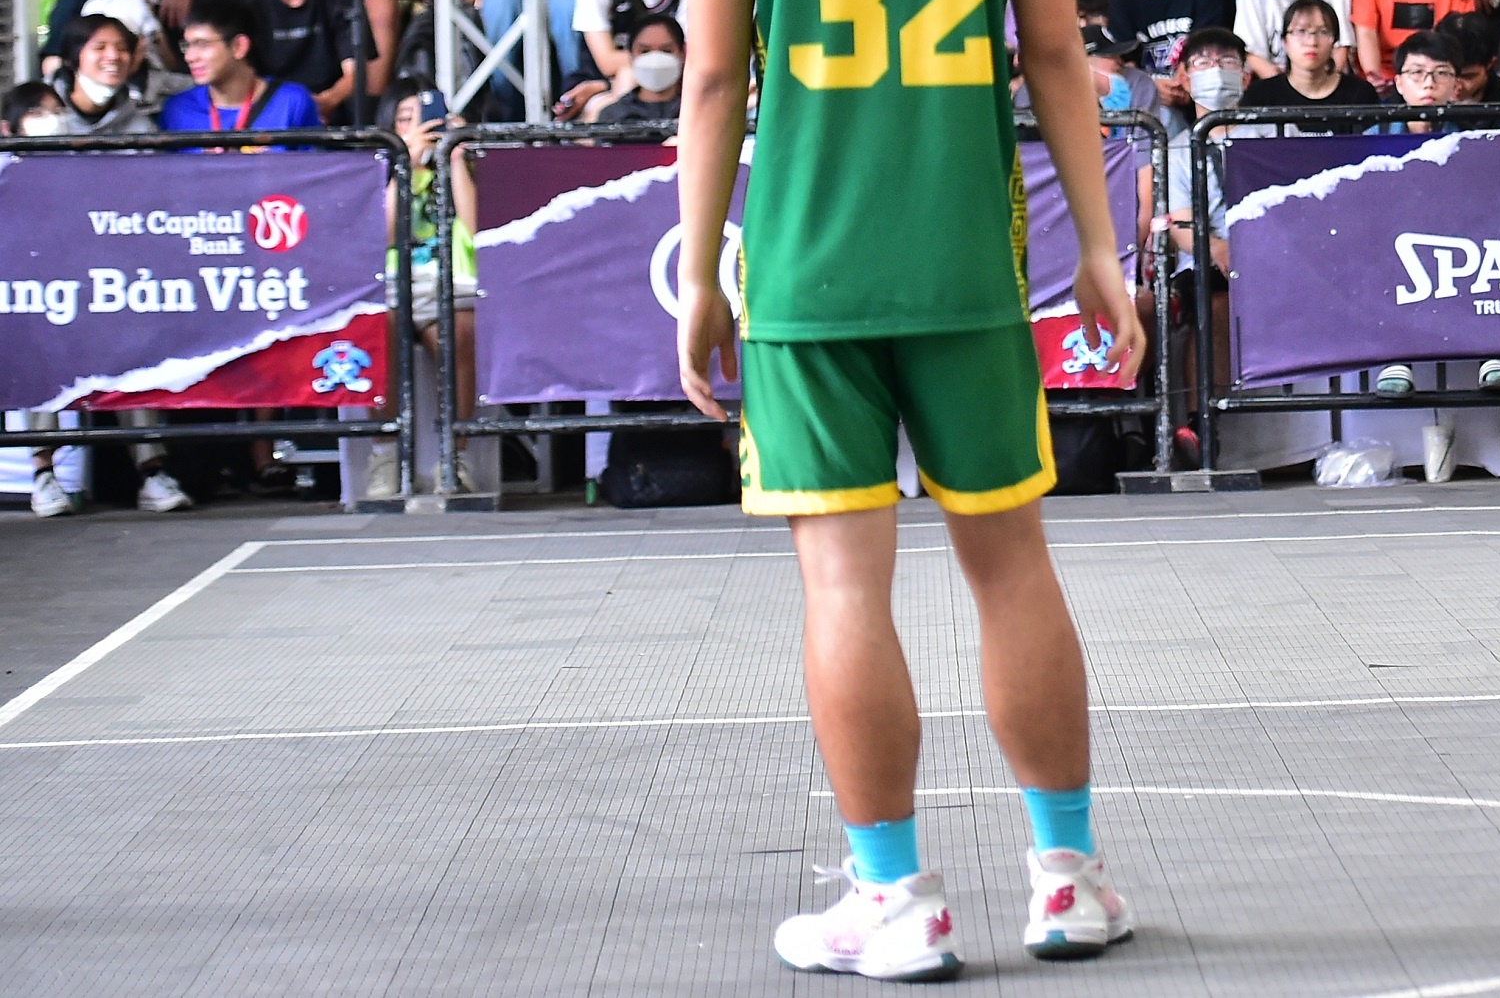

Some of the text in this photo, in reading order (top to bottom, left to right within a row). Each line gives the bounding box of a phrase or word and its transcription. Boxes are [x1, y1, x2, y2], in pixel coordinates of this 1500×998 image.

[88, 210, 245, 238] Viet Capital
[189, 236, 245, 255] Bank
[88, 268, 197, 313] Bản
[199, 266, 309, 320] Việt
